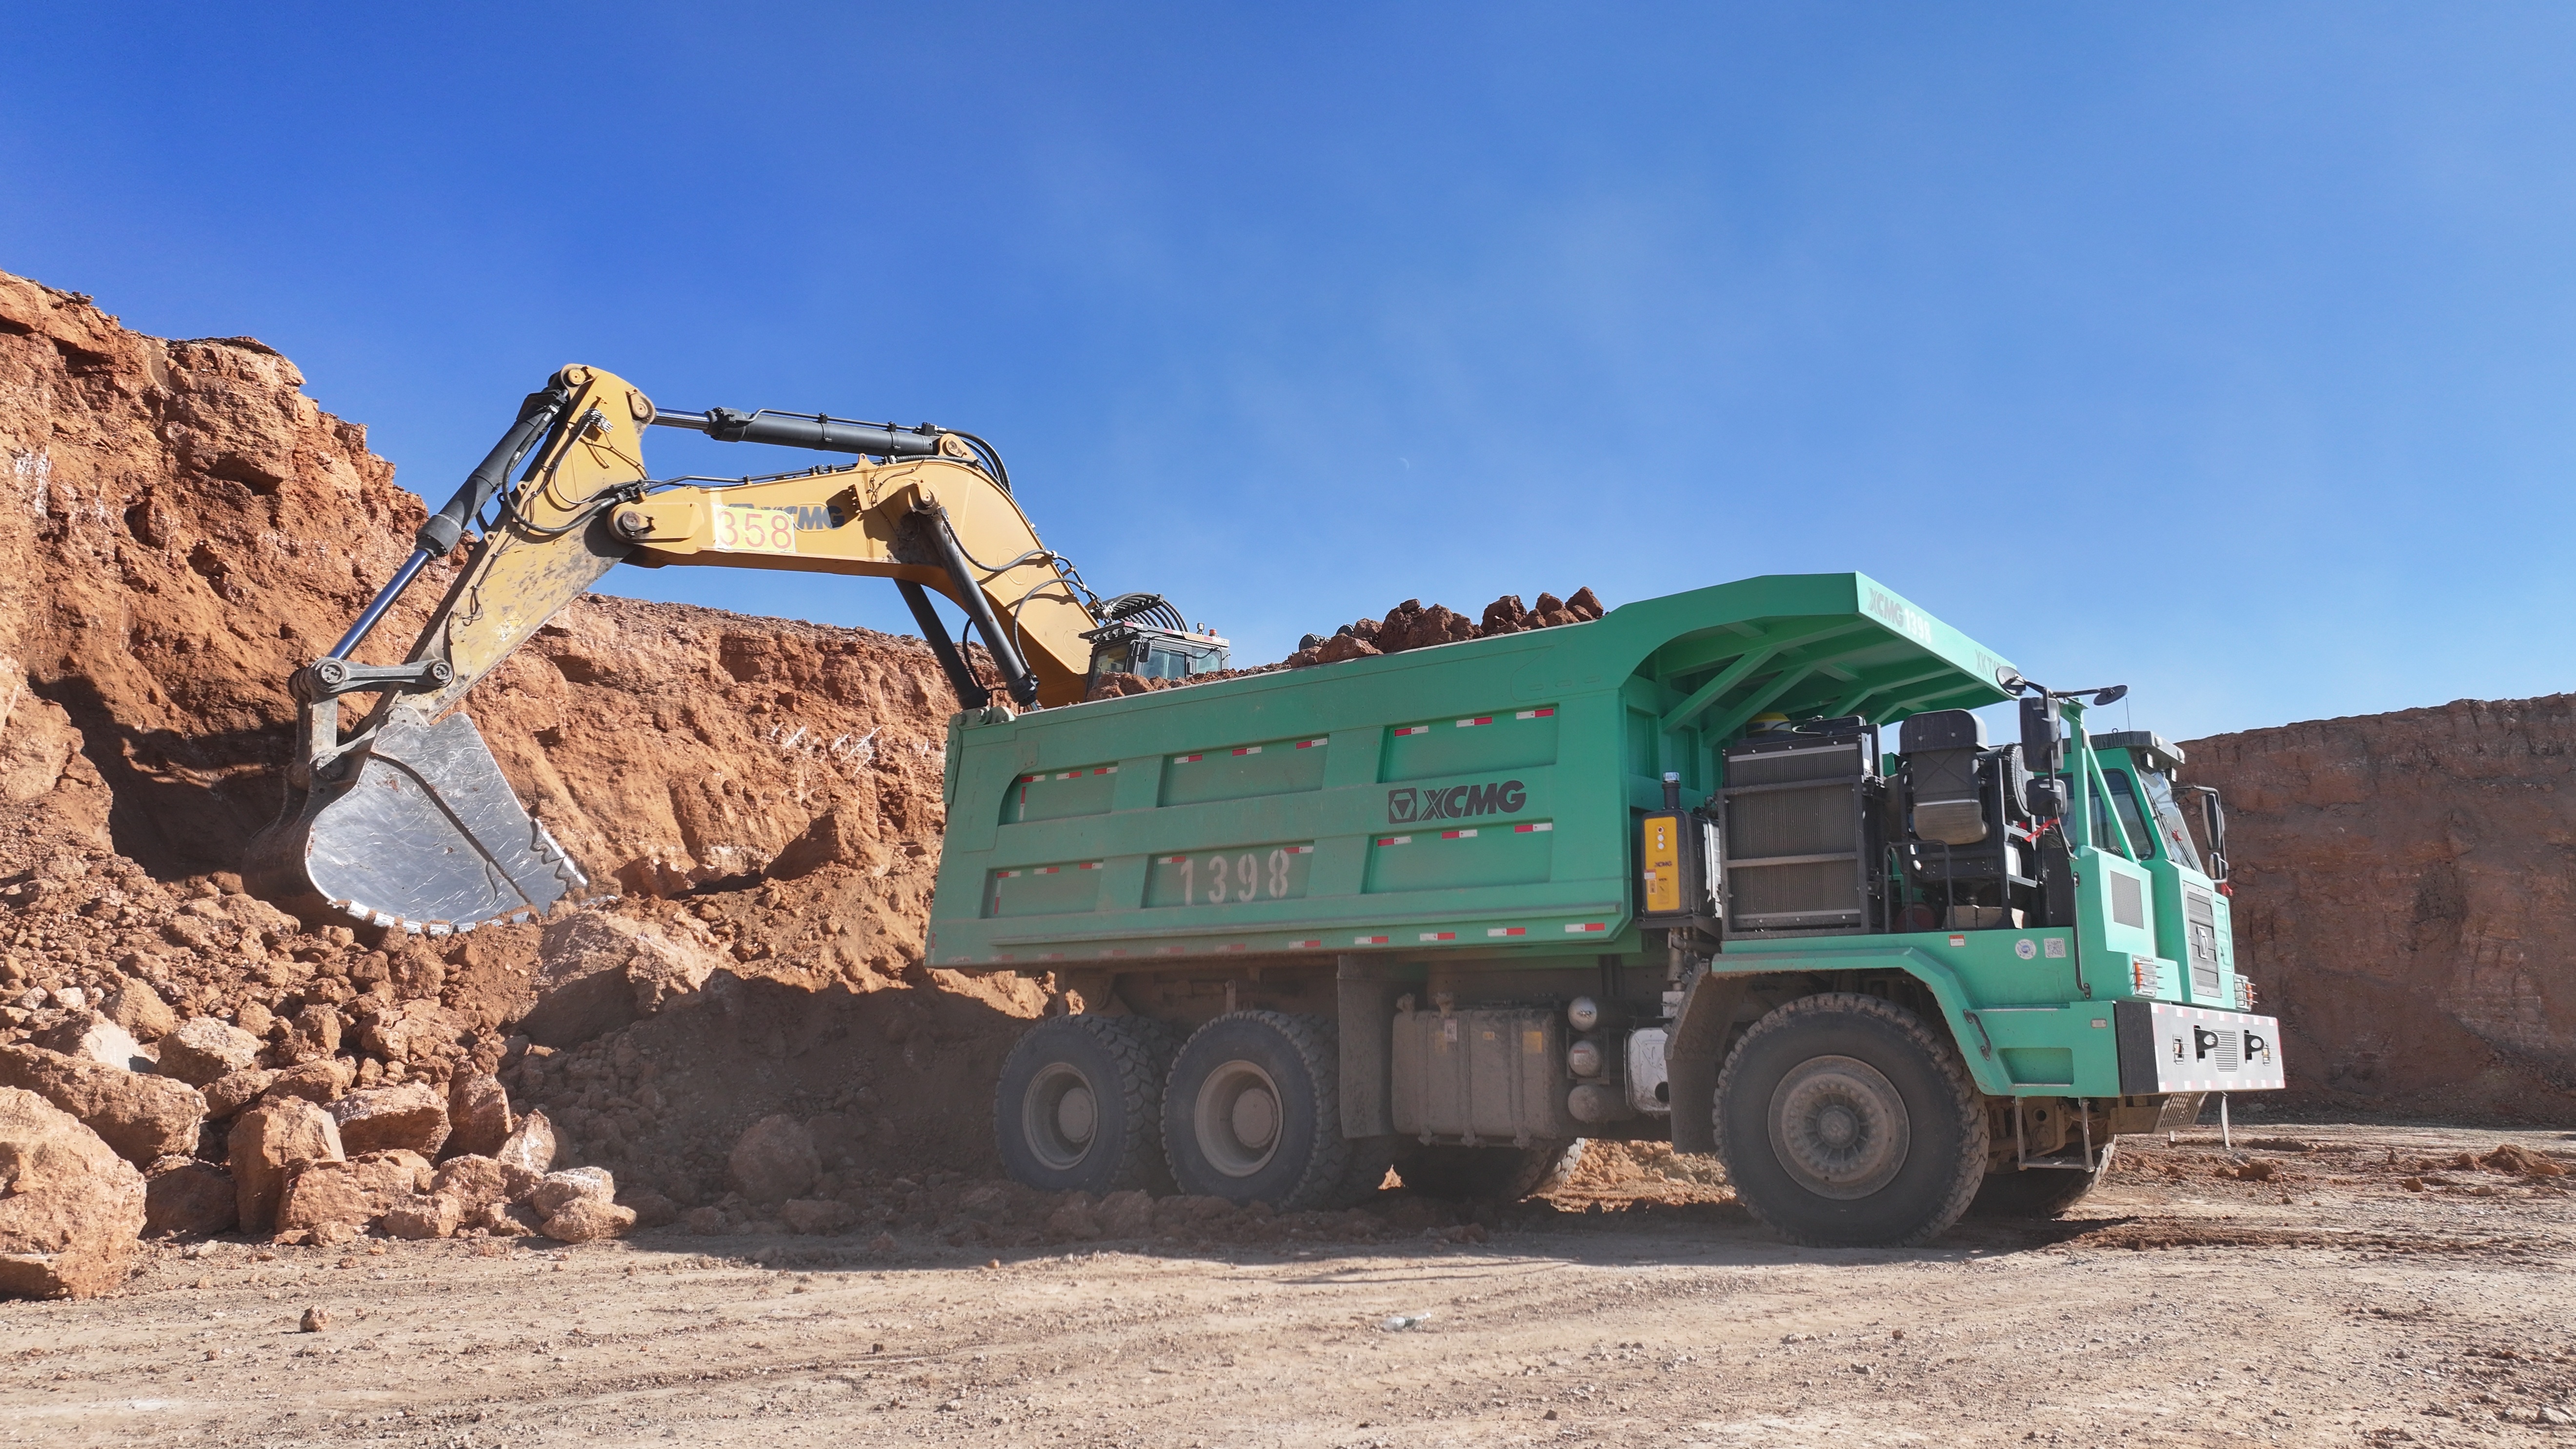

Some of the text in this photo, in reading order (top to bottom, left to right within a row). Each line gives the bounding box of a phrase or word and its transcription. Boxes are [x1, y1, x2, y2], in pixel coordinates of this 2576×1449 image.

[717, 511, 791, 549] 358
[1868, 587, 1931, 644] XCMG 1398
[1418, 780, 1526, 821] XCMG
[1180, 849, 1289, 906] 1398
